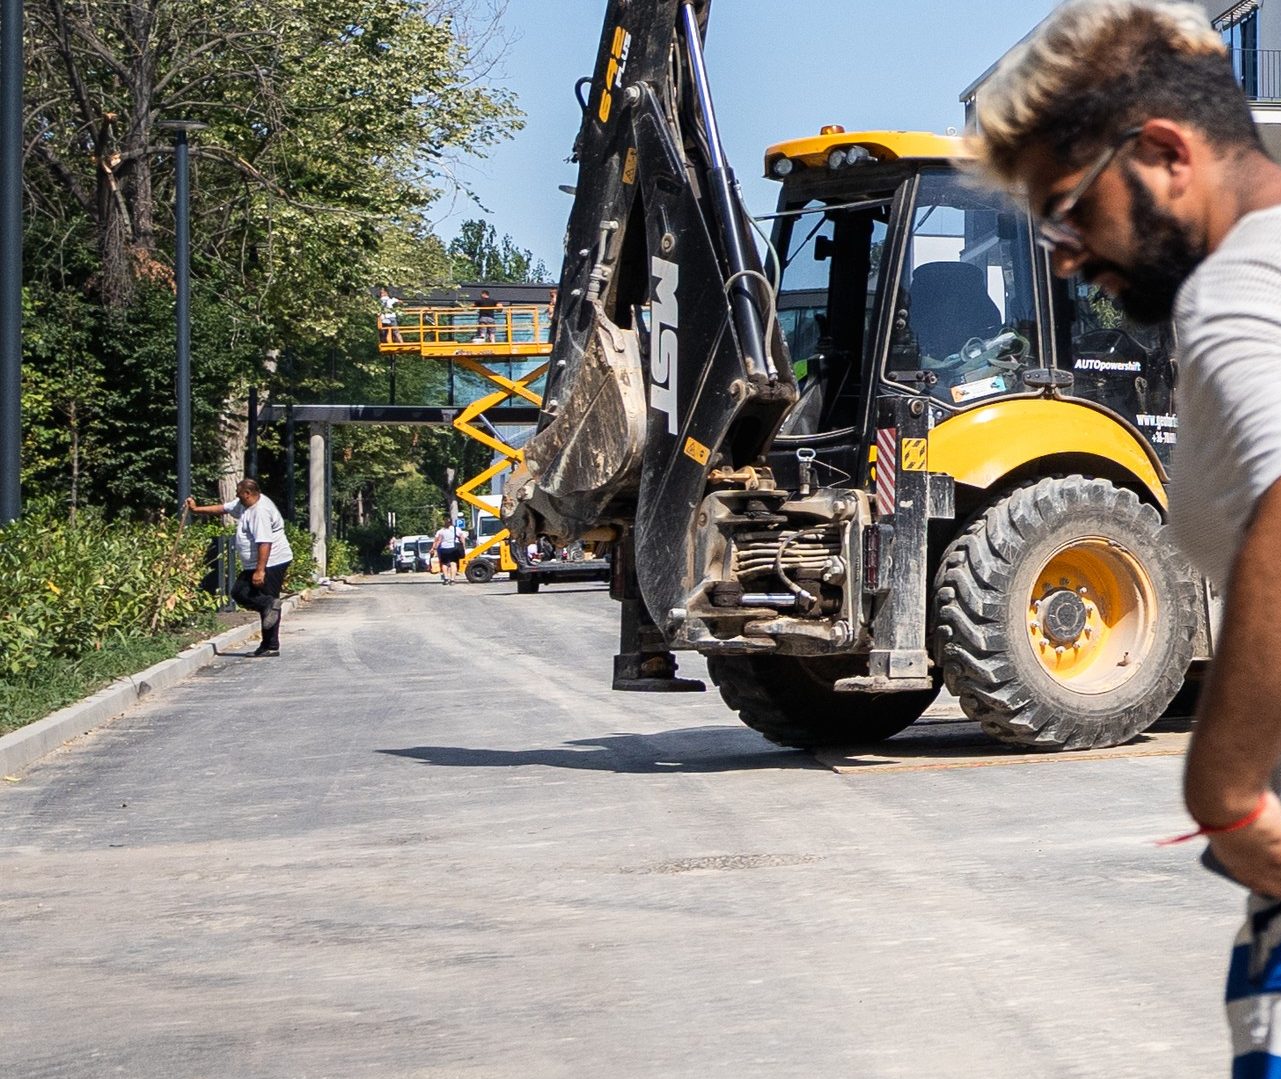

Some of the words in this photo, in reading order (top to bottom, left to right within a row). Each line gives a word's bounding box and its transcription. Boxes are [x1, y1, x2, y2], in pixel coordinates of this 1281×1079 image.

[598, 25, 626, 123] 642
[615, 31, 631, 88] PLUS
[651, 255, 679, 436] MST
[1074, 359, 1142, 371] AUTOpowershift
